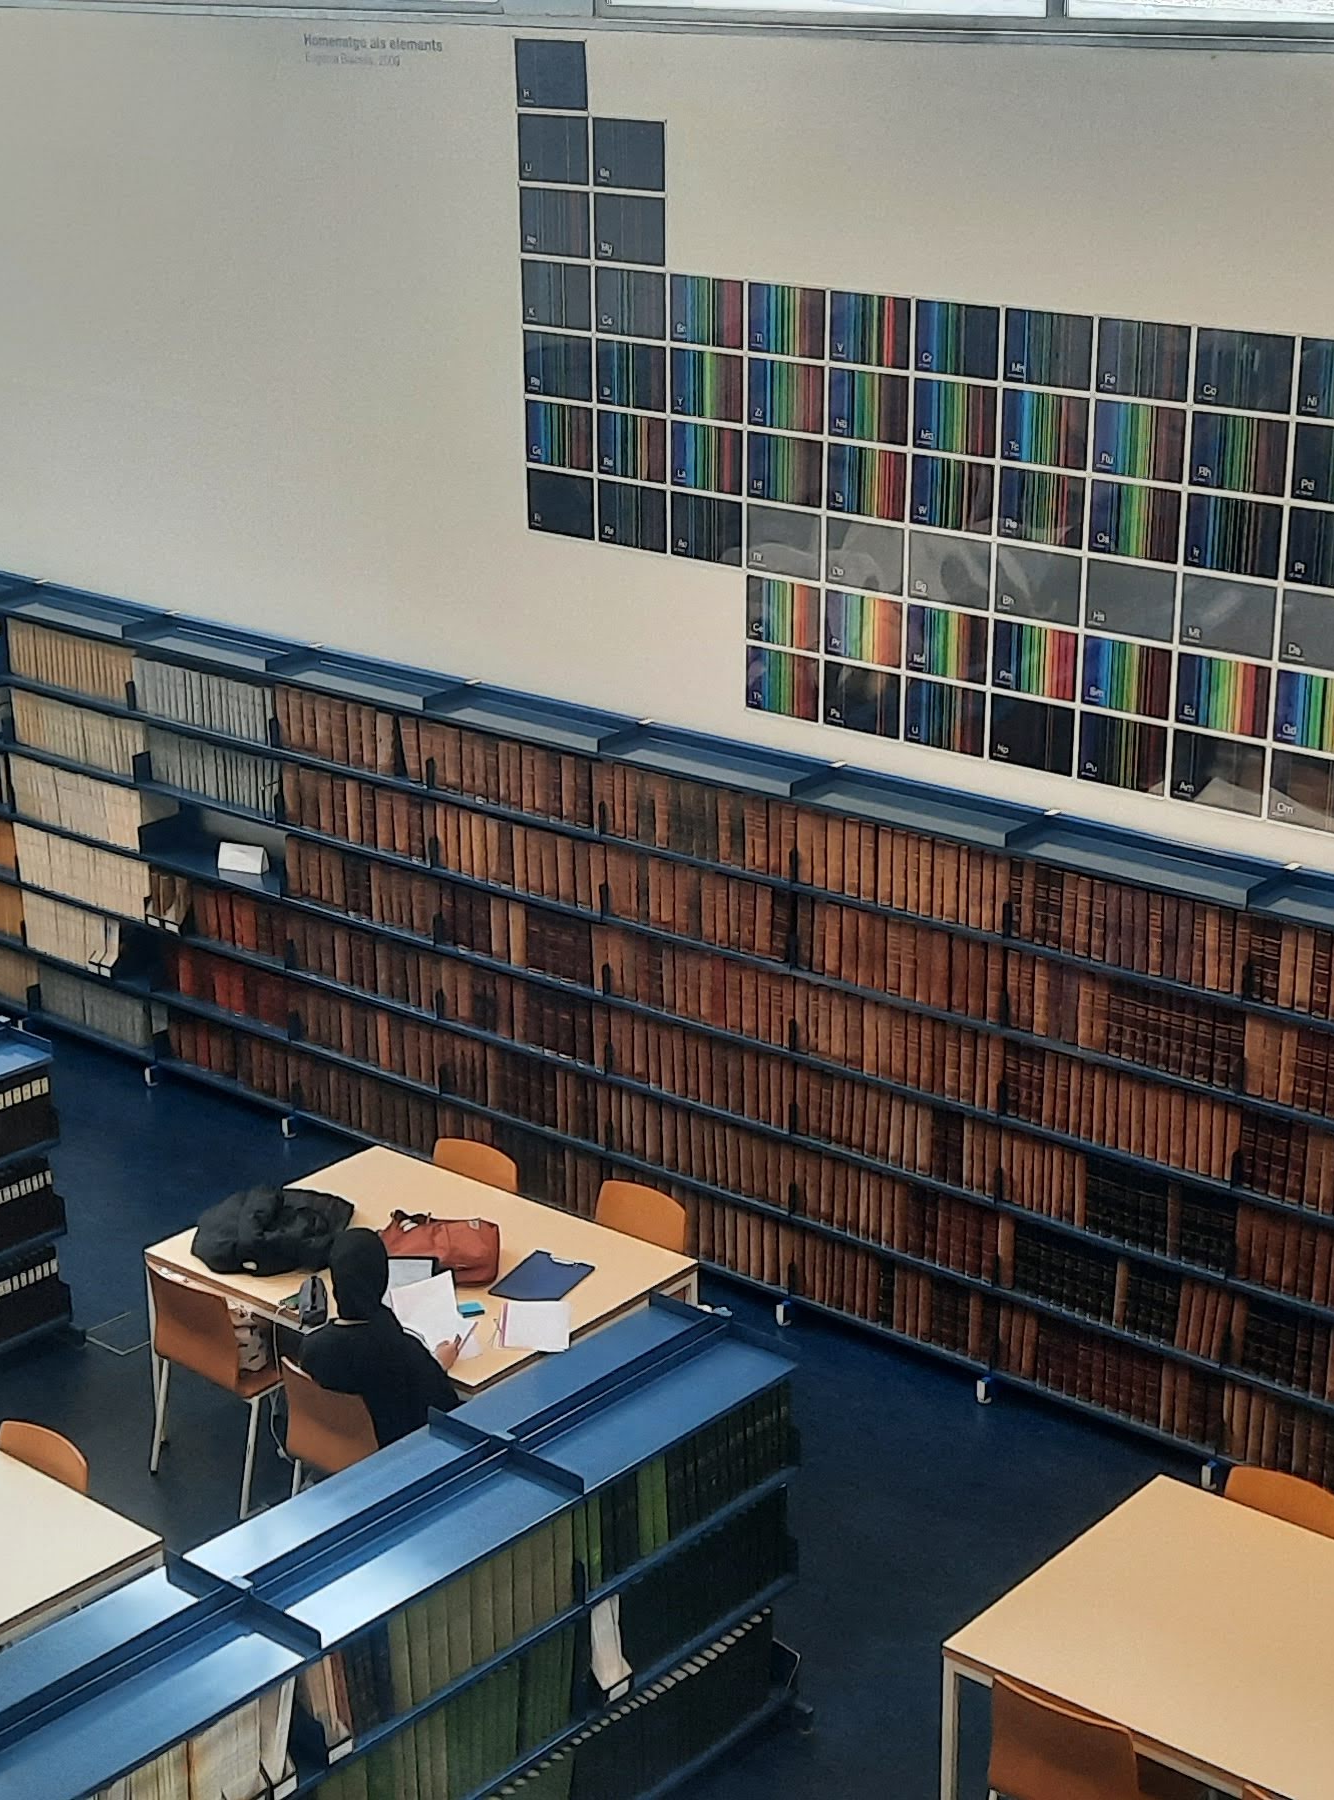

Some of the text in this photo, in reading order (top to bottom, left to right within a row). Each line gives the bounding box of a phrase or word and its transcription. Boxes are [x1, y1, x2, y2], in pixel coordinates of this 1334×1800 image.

[370, 37, 385, 49] als
[528, 307, 535, 317] K
[836, 343, 843, 352] V
[922, 353, 933, 364] Cr
[1104, 373, 1116, 385] Fe
[1203, 384, 1217, 396] Co
[677, 398, 683, 406] Y
[1301, 478, 1314, 491] Pd
[1184, 705, 1195, 716] Eu
[912, 726, 919, 736] U
